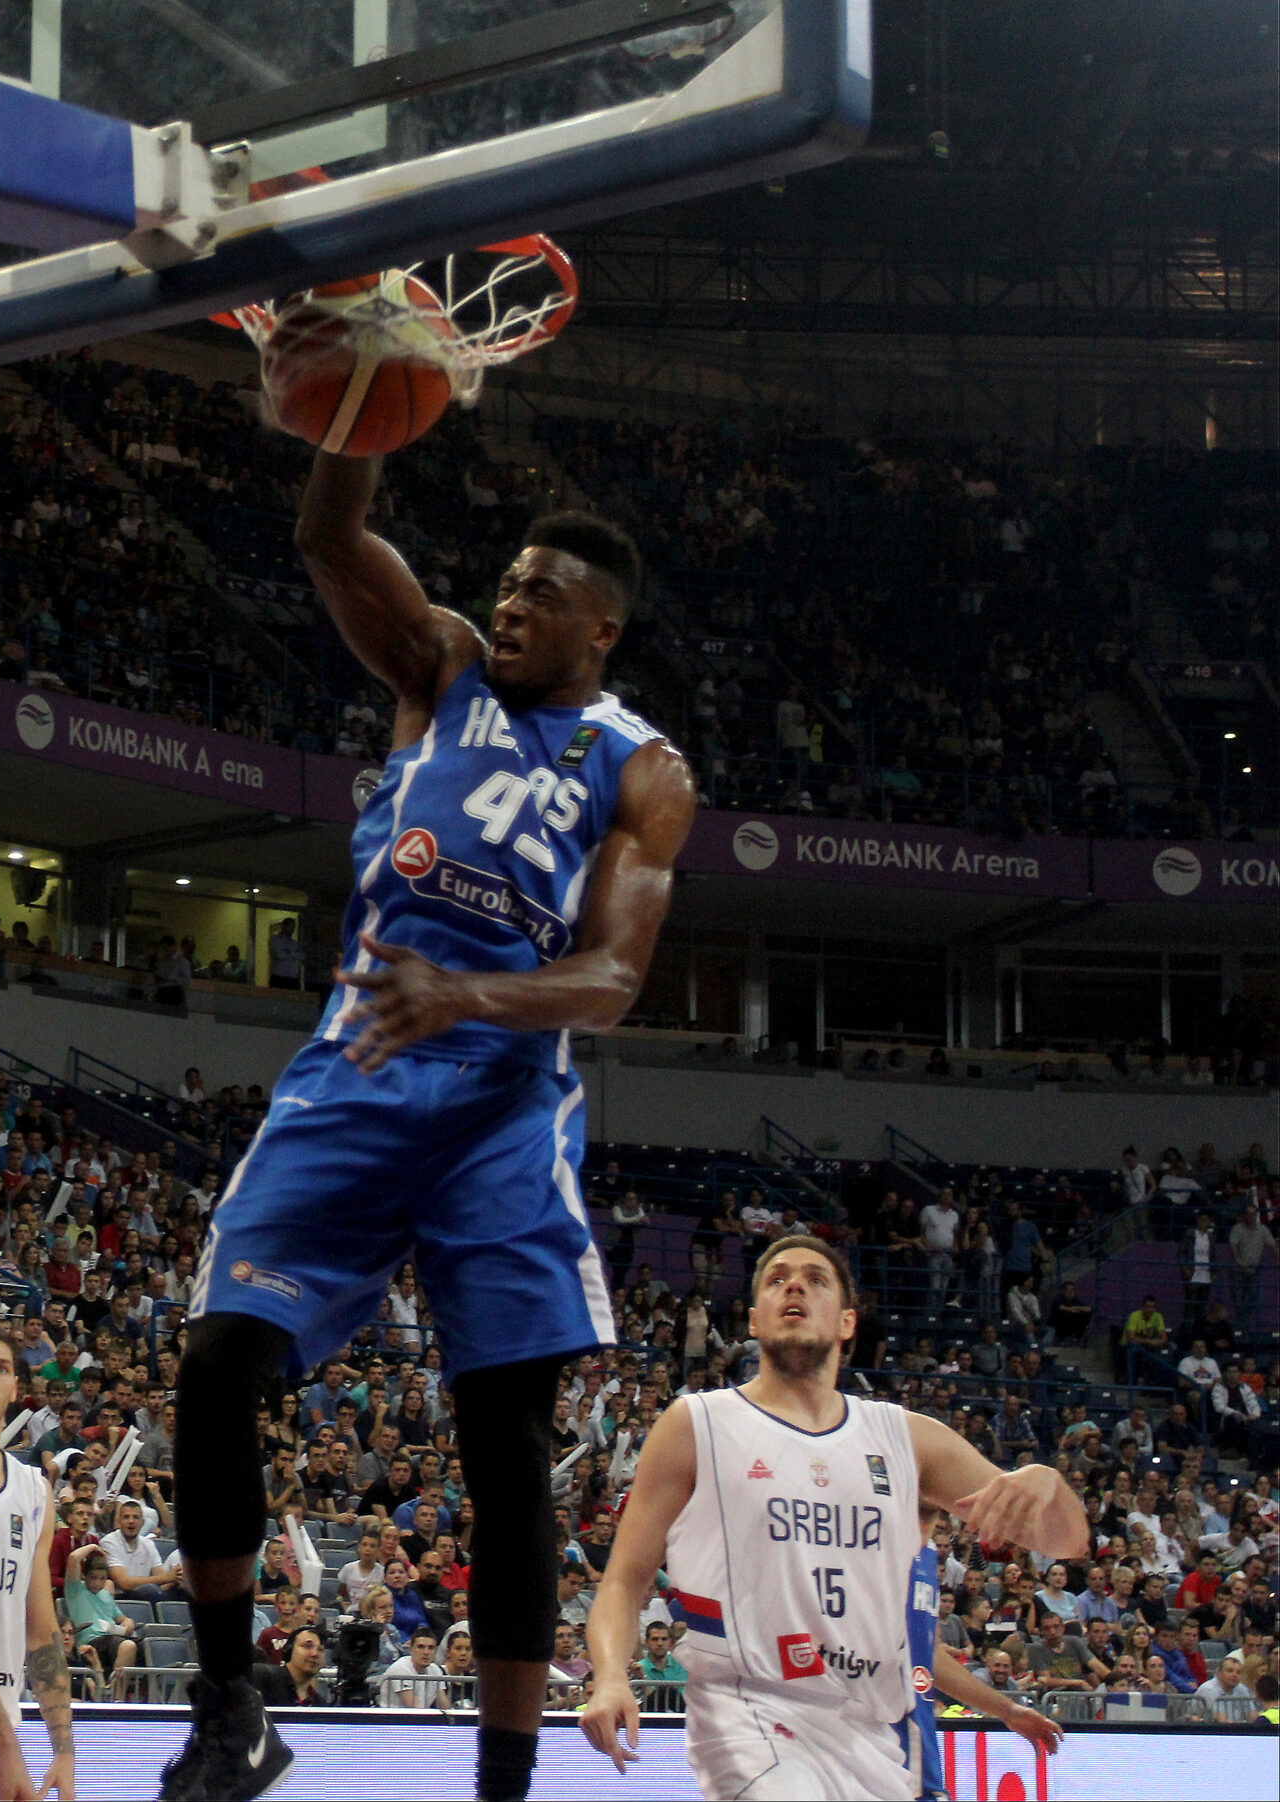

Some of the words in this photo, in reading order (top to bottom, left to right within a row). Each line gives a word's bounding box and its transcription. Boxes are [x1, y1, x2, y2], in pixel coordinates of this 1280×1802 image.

[70, 716, 188, 770] KOMBANK
[796, 835, 943, 871] KOMBANK
[952, 847, 1039, 878] Arena
[768, 1497, 882, 1550] SRBIJA
[812, 1567, 845, 1618] 15
